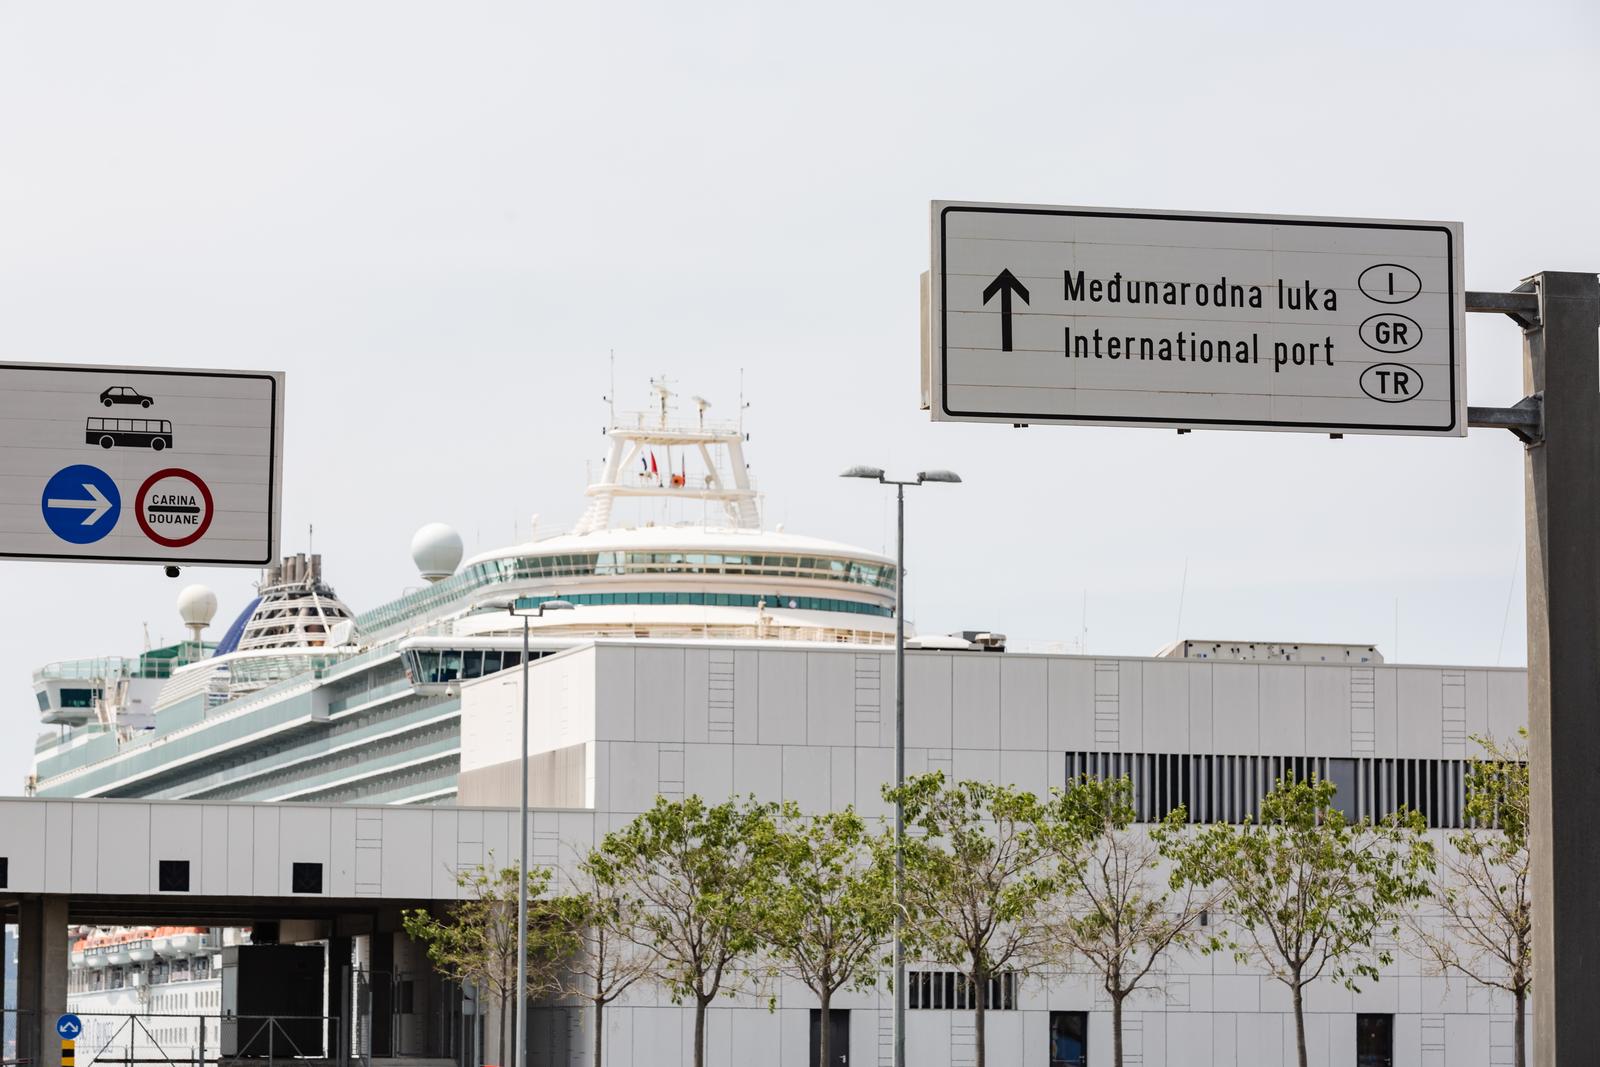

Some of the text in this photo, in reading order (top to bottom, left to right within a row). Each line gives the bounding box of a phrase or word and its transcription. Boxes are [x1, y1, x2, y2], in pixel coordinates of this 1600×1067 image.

[1064, 270, 1337, 311] Međunarodna luka
[1375, 321, 1408, 345] GR
[1064, 327, 1334, 372] International port
[1375, 371, 1409, 395] TR
[152, 494, 196, 505] CARINA
[149, 513, 199, 524] DOUANE
